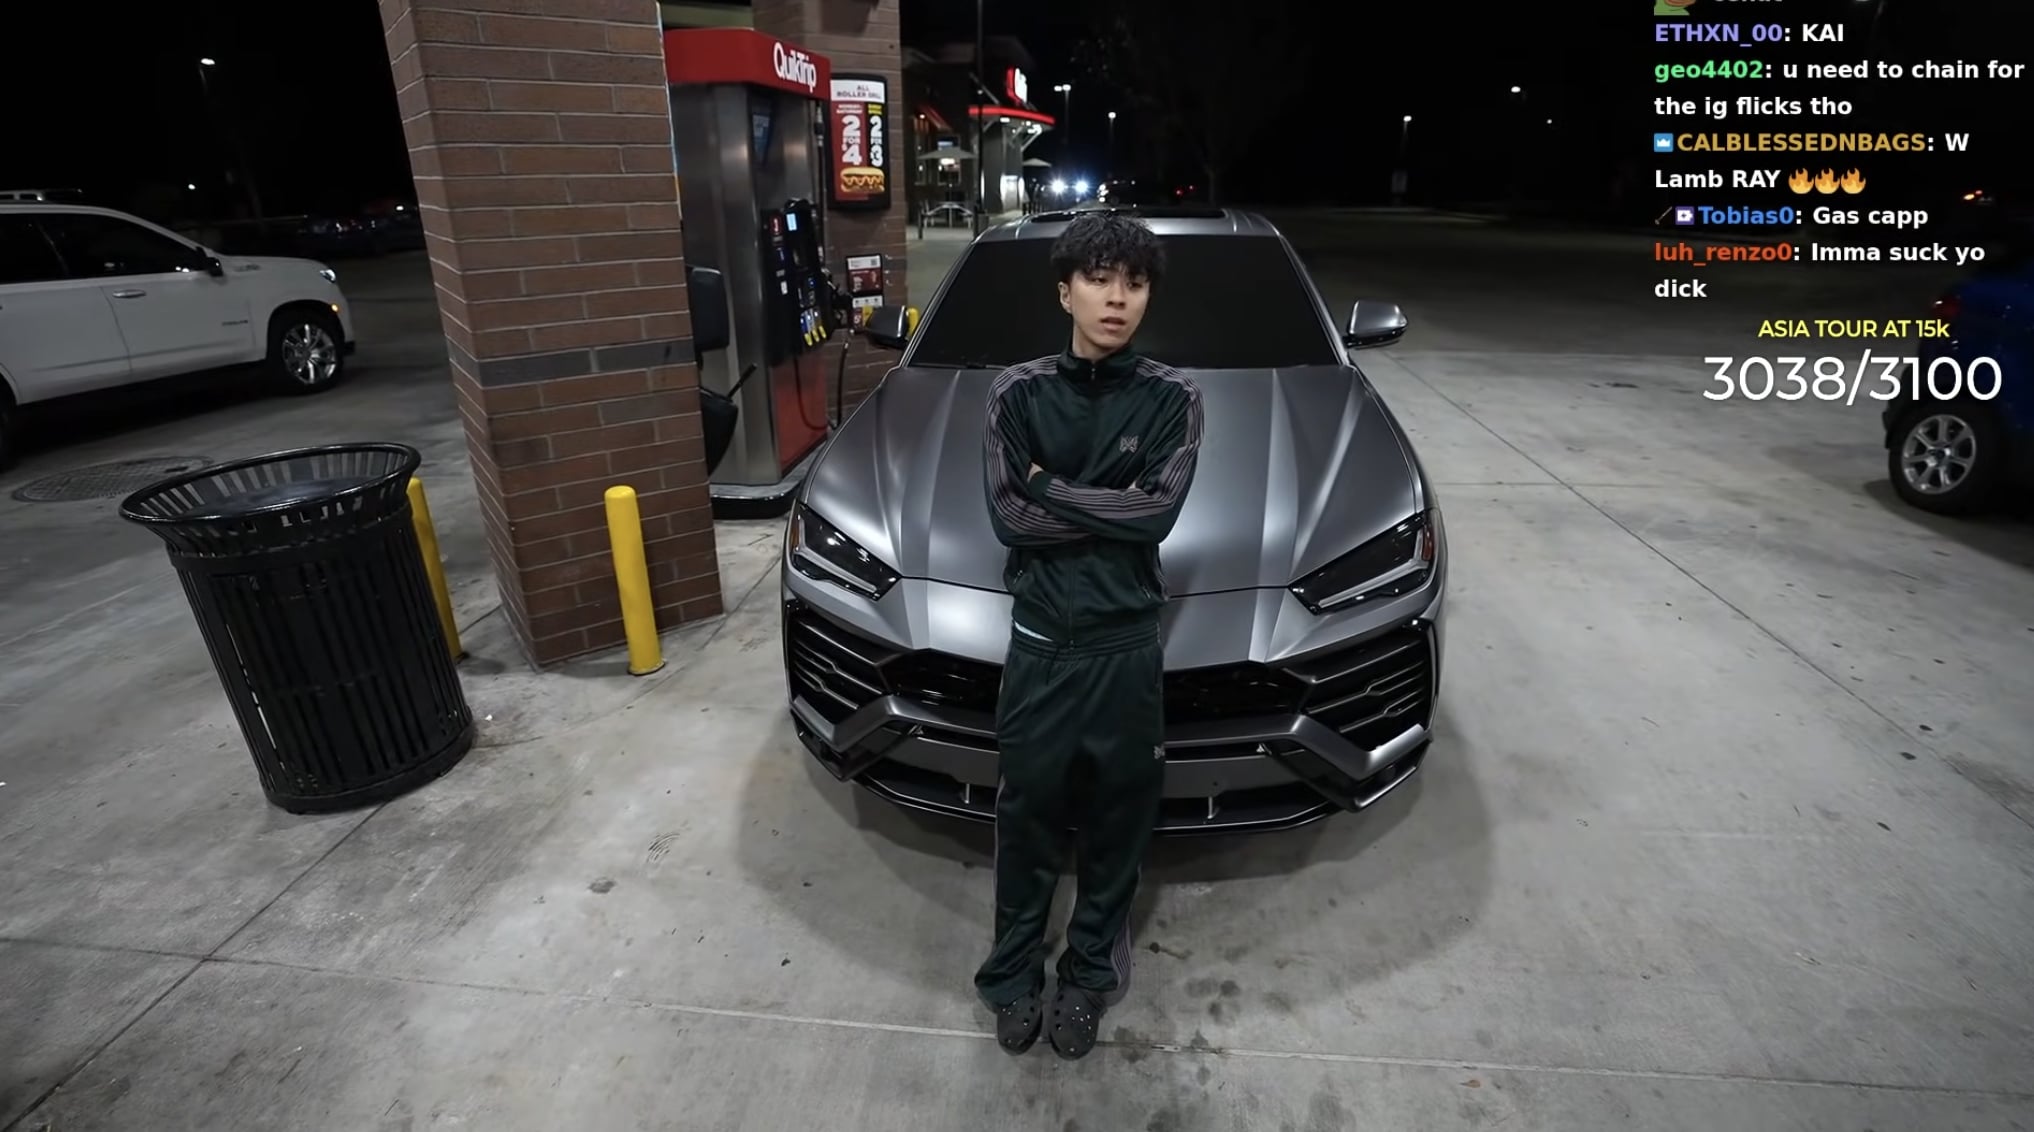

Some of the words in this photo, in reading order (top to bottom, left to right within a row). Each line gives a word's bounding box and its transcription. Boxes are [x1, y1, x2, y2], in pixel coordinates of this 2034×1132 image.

[773, 41, 817, 94] QuikTrip
[841, 114, 861, 137] 2
[870, 115, 882, 138] 2
